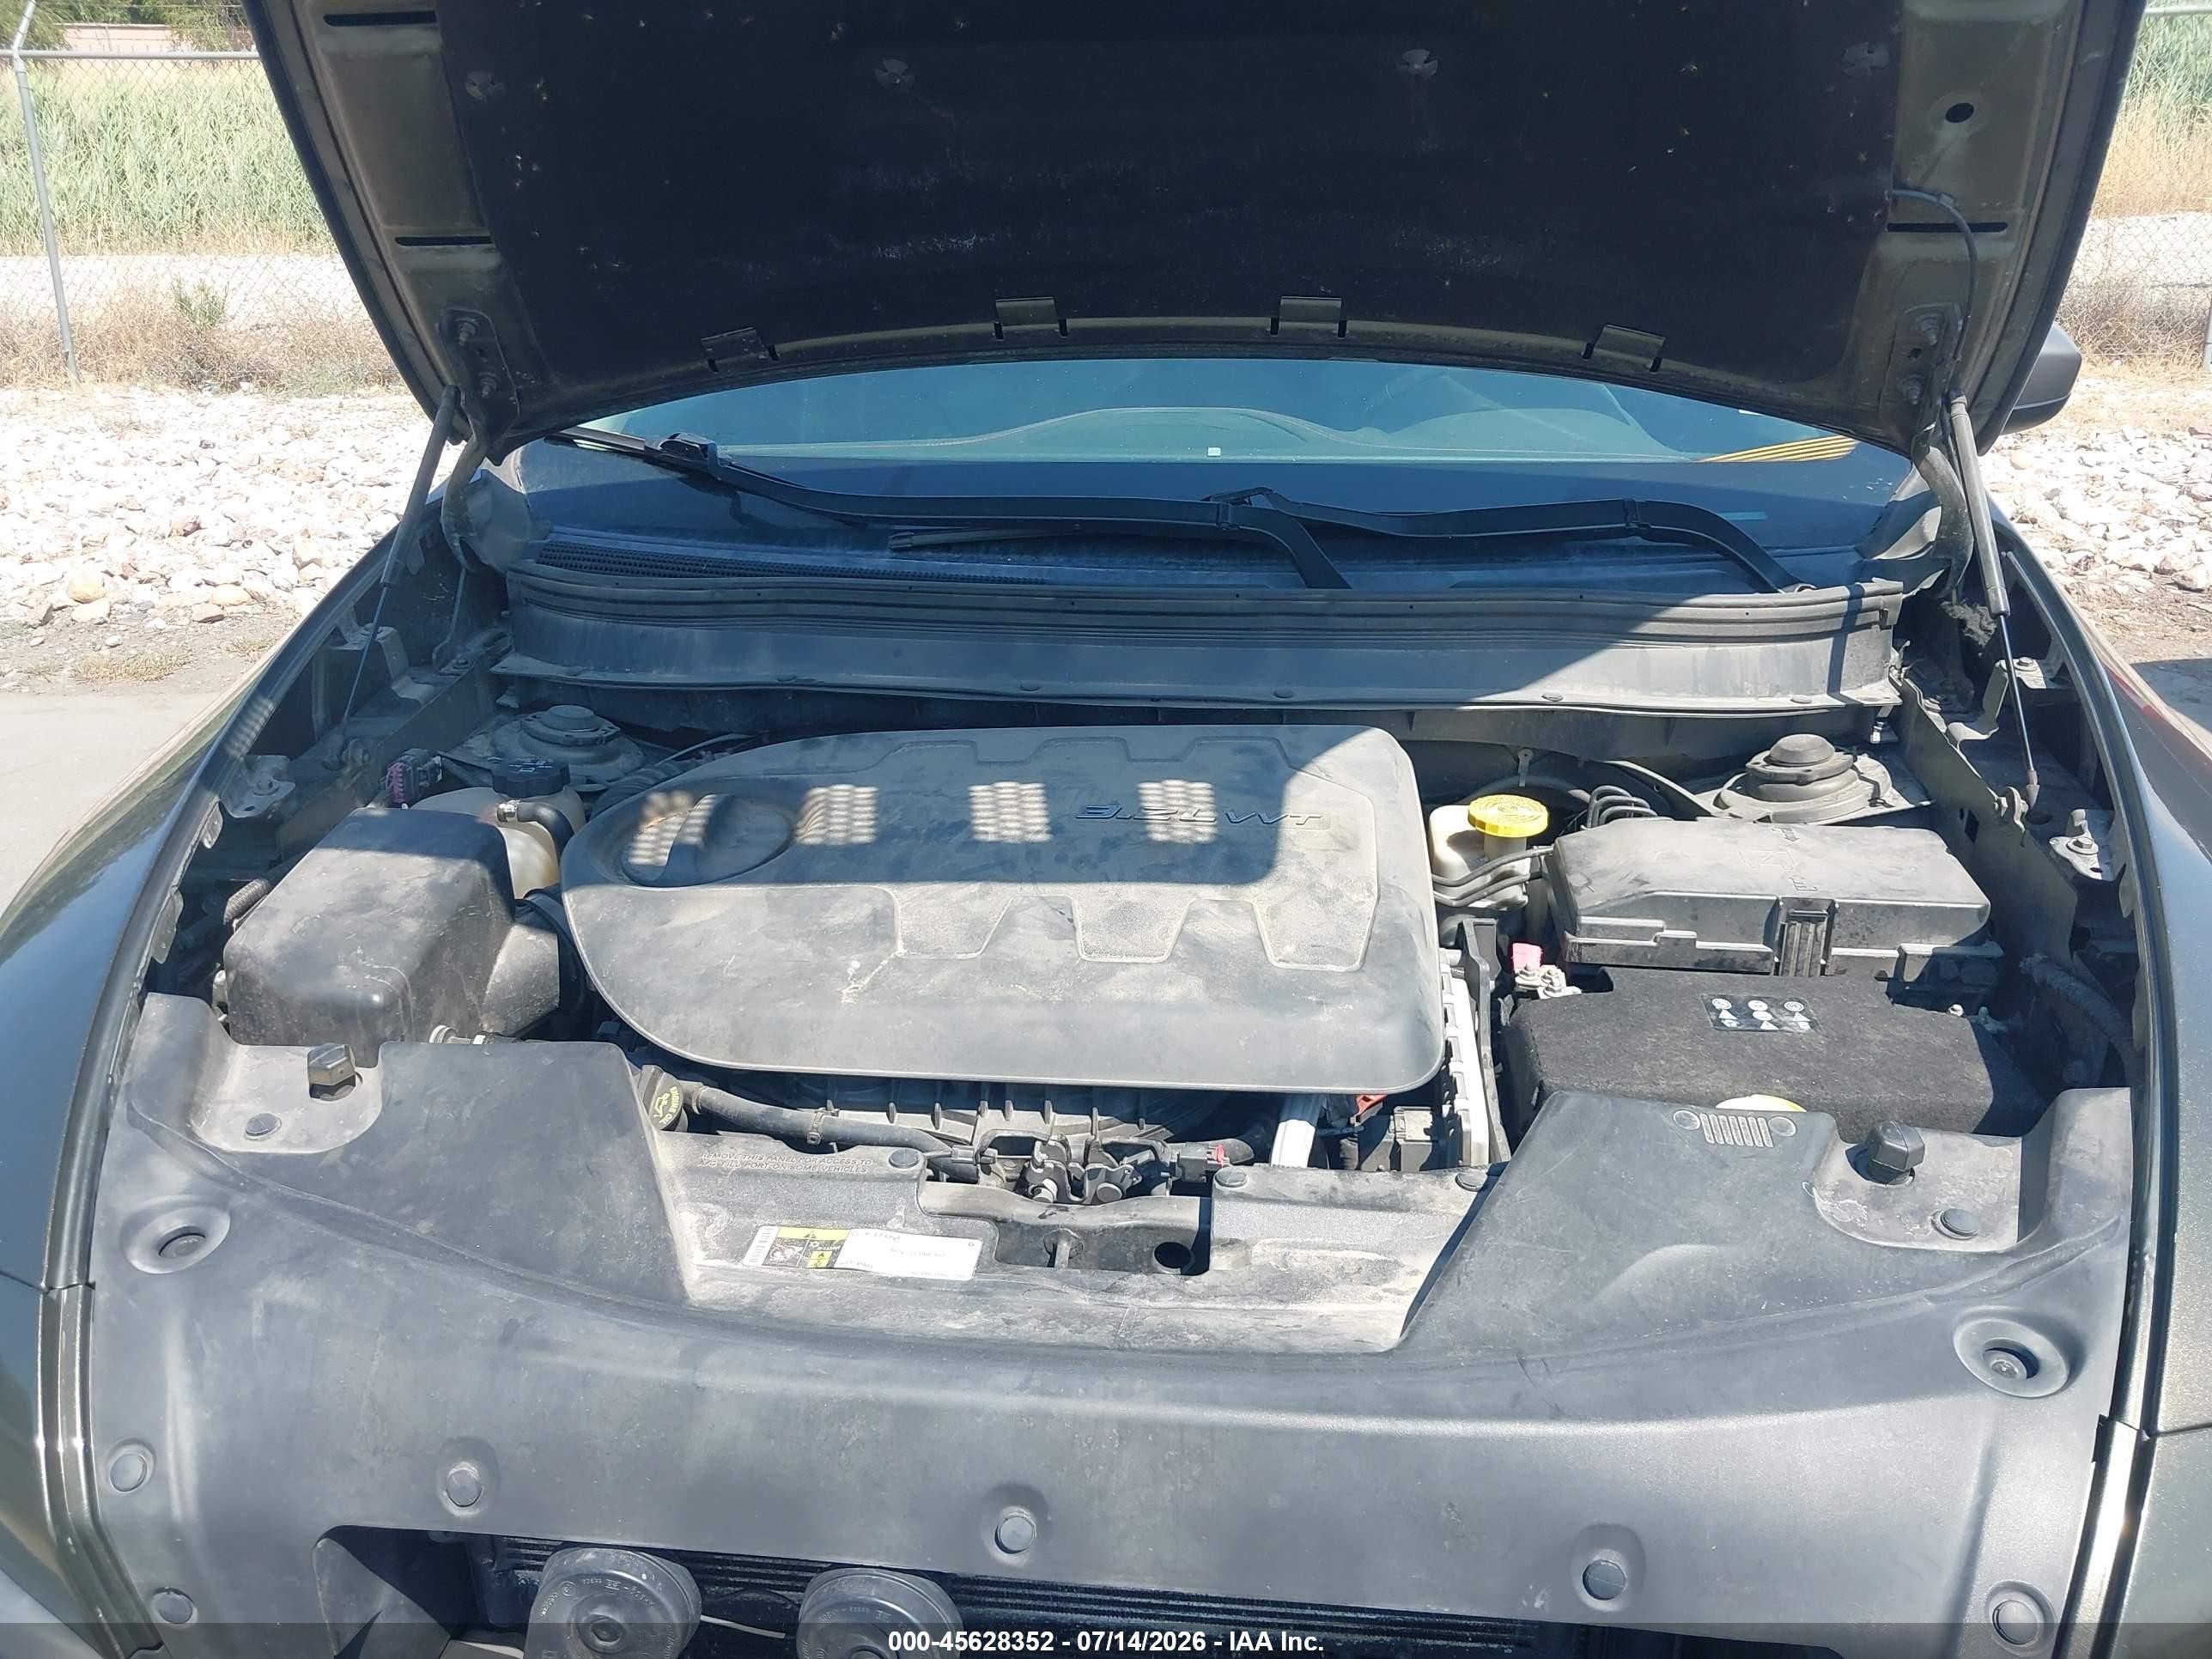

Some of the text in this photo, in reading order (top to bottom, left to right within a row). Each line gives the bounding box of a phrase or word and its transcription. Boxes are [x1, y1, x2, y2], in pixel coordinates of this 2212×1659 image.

[1225, 811, 1323, 825] VVT
[659, 1086, 680, 1125] ENGINE OIL
